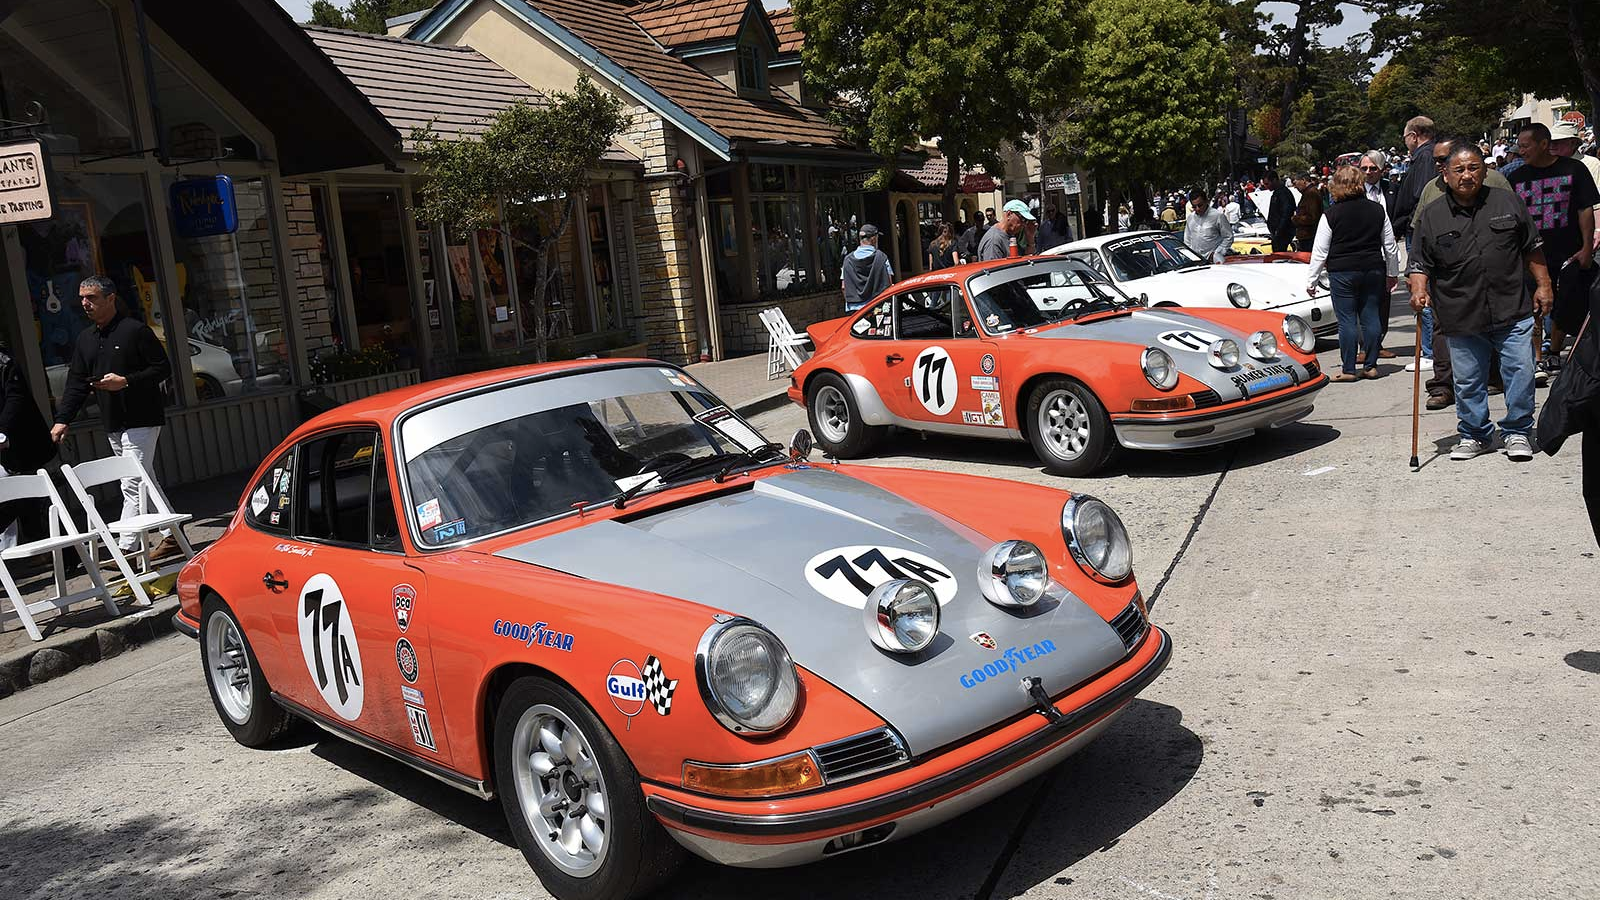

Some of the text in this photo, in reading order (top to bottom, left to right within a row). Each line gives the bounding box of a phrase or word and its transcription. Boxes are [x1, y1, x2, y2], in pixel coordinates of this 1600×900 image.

[1161, 331, 1212, 351] 77
[918, 352, 948, 409] 77
[1230, 369, 1268, 387] QUAKER
[304, 588, 360, 706] 77A
[607, 676, 646, 699] Gulf
